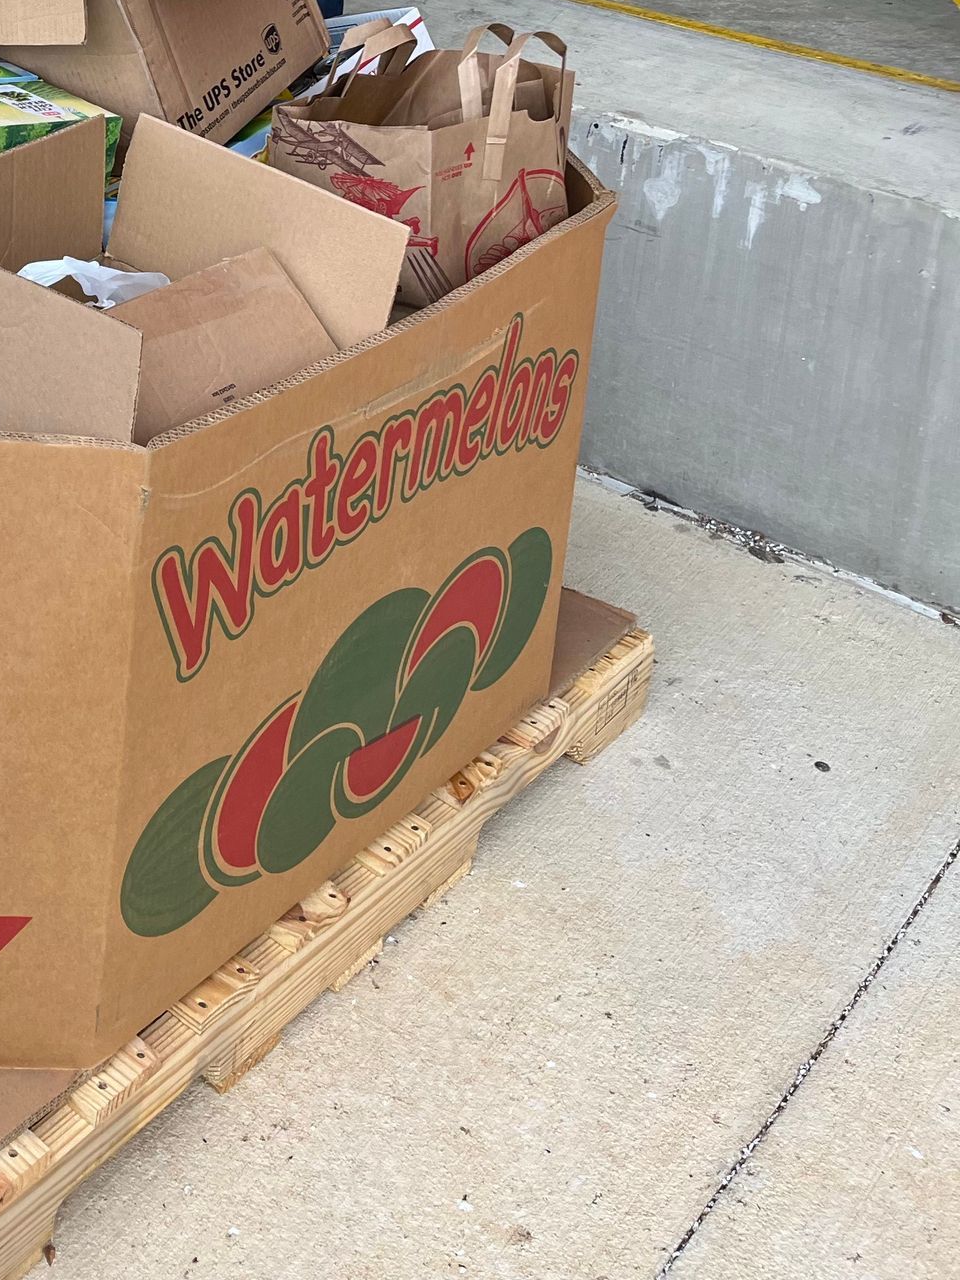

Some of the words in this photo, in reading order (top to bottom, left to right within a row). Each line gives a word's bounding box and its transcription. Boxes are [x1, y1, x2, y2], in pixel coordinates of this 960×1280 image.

[265, 32, 280, 51] ups
[176, 107, 203, 131] The
[203, 78, 231, 112] UPS
[231, 53, 265, 89] Store
[151, 311, 580, 683] Watermelons
